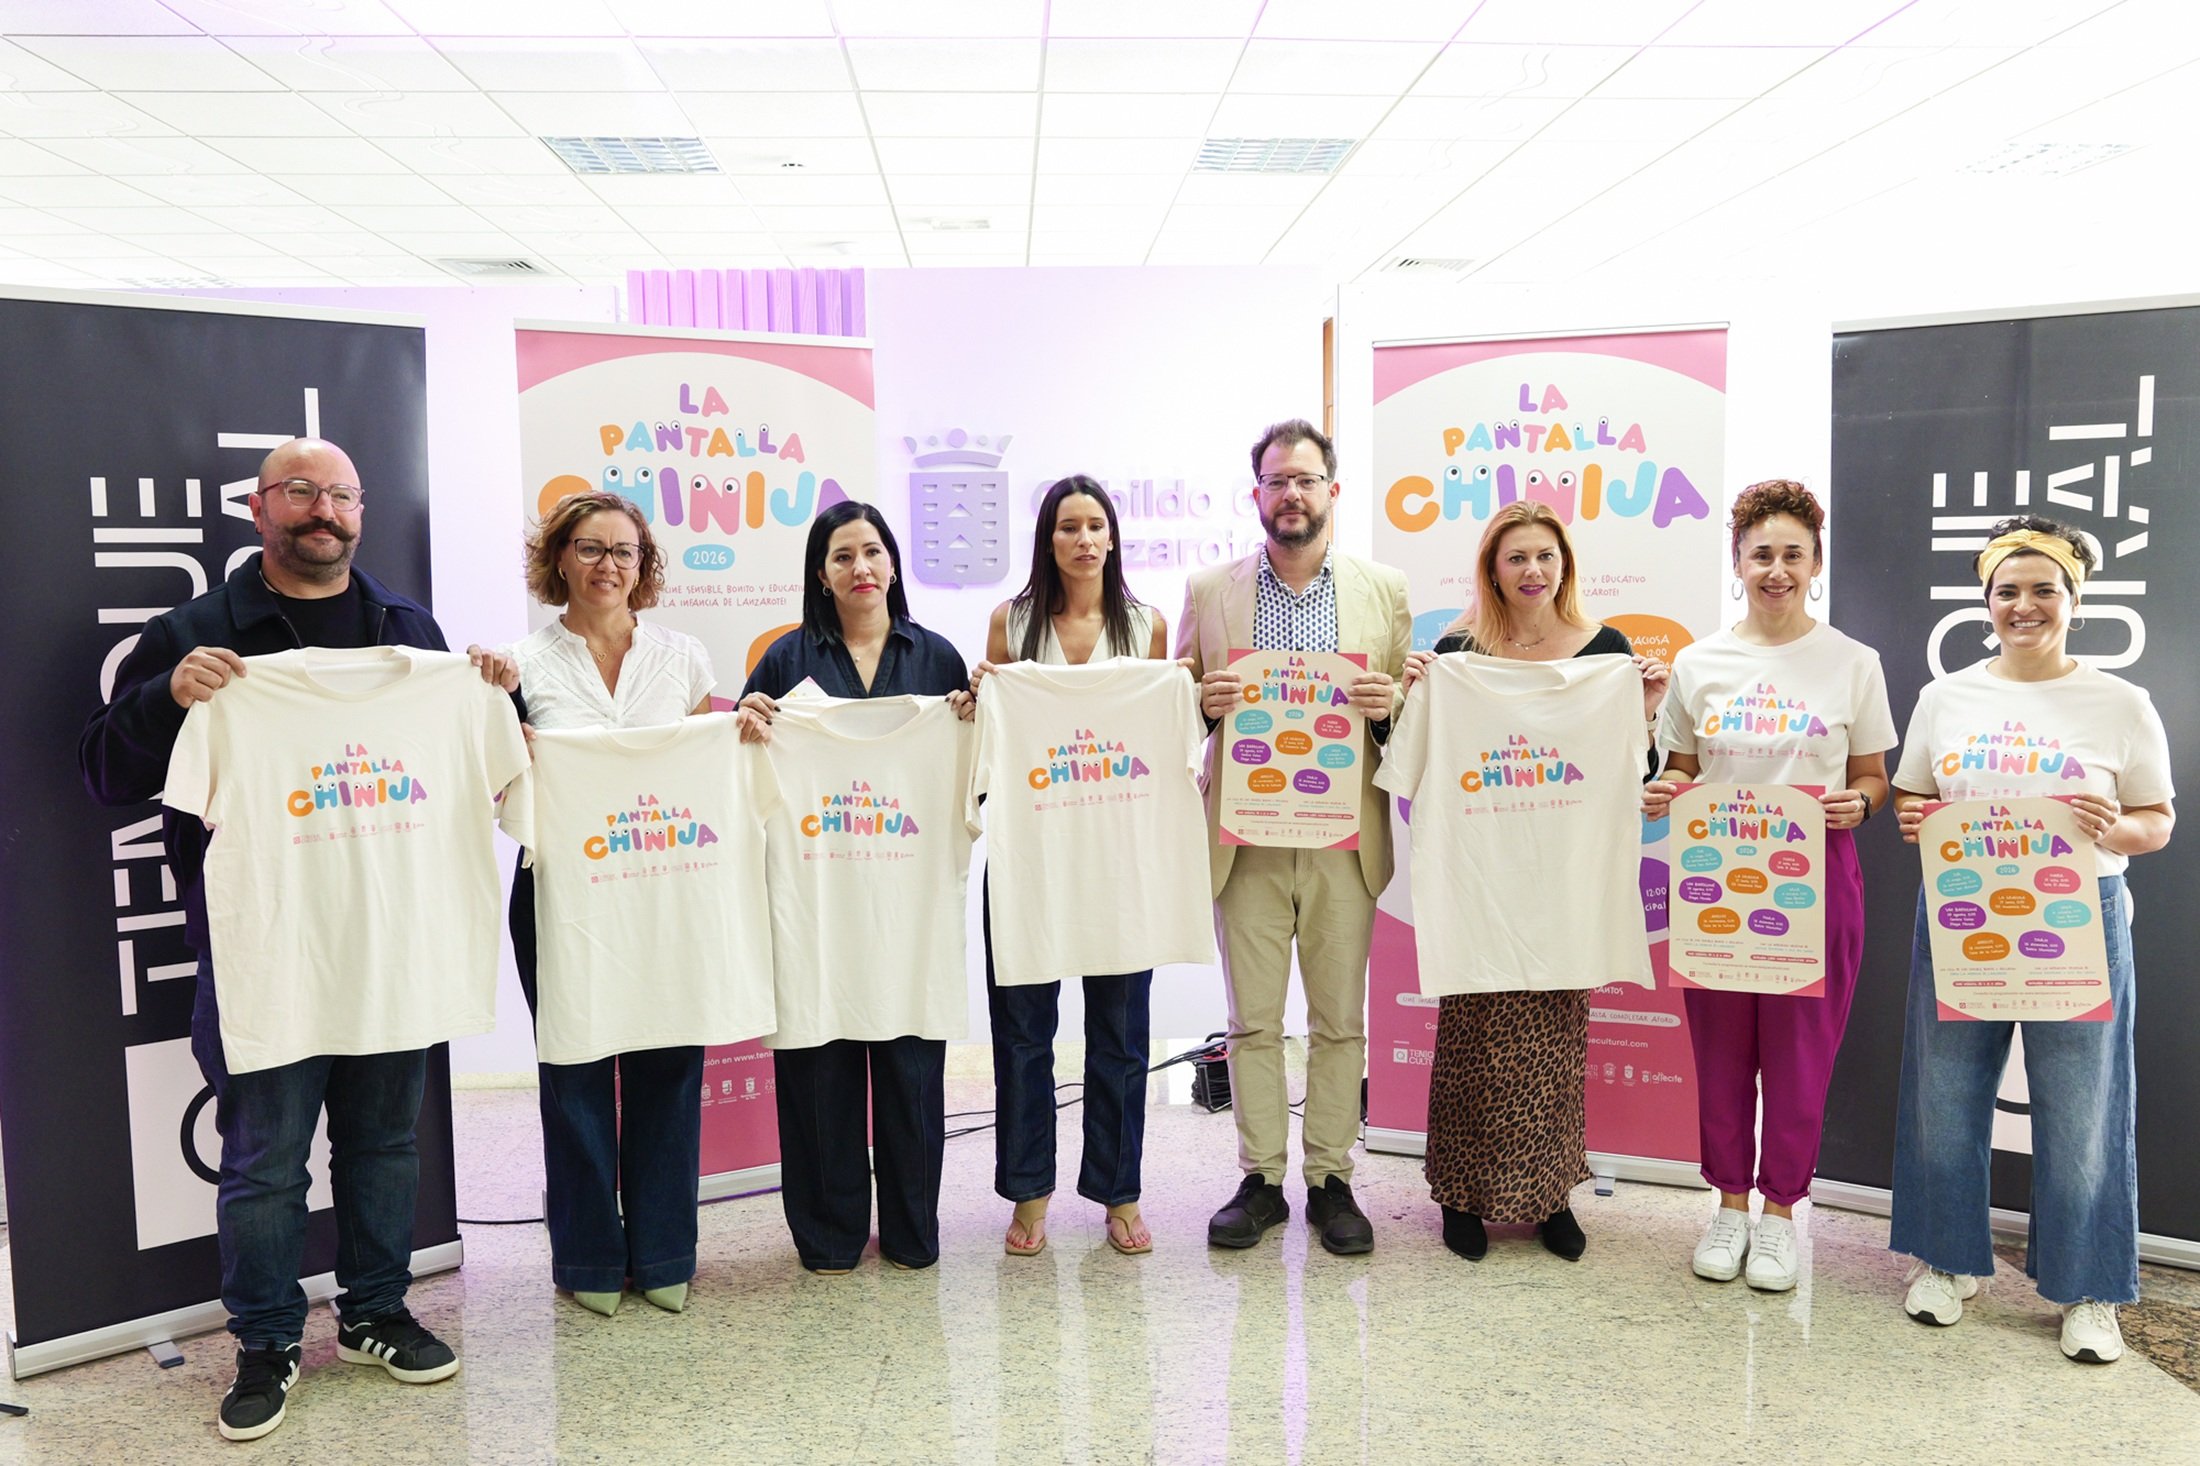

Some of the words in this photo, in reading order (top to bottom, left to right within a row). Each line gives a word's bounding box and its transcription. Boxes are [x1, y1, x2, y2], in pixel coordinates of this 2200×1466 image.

[679, 383, 730, 417] LA
[1519, 383, 1568, 414] LA
[599, 420, 806, 463] PANTALLA
[1443, 416, 1647, 457] PANTALLA
[1031, 478, 1205, 518] bildo
[1385, 460, 1710, 533] CHINIJA
[692, 550, 727, 566] 2026
[1458, 577, 1472, 585] CICL
[1601, 575, 1646, 583] EDUCATIVO
[727, 585, 755, 594] BONITO
[769, 584, 805, 593] EDUCATIV
[663, 599, 676, 608] LA
[680, 599, 719, 608] INFANCIA
[723, 597, 732, 607] DE
[1627, 634, 1670, 646] RACIOSA
[1289, 656, 1305, 667] LA
[1263, 668, 1330, 683] PANTALLA
[1242, 682, 1349, 707] CHINIJA
[1757, 683, 1776, 695] LA
[1704, 711, 1828, 737] CHINIJA
[2004, 721, 2026, 732] LA
[1075, 729, 1095, 740] LA
[1509, 734, 1528, 746] LA
[1967, 734, 2060, 750] PANTALLA
[346, 743, 368, 757] LA
[1048, 741, 1125, 759] PANTALLA
[1481, 746, 1559, 763] PANTALLA
[311, 758, 404, 780] PANTALLA
[1028, 755, 1150, 790] CHINIJA
[1942, 749, 2086, 780] CHINIJA
[1460, 761, 1584, 792] CHINIJA
[853, 780, 871, 792] LA
[287, 776, 427, 817] CHINIJA
[638, 794, 659, 807] LA
[822, 794, 899, 810] PANTALLA
[1737, 789, 1756, 801] LA
[606, 807, 692, 827] PANTALLA
[1709, 802, 1784, 816] PANTALLA
[1990, 805, 2011, 817] LA
[800, 811, 919, 837] CHINIJA
[1687, 816, 1806, 843] CHINIJA
[1960, 819, 2045, 834] PANTALLA
[584, 822, 718, 860] CHINIJA
[1940, 833, 2073, 862] CHINIJA
[1646, 887, 1667, 897] 12:00
[1645, 902, 1666, 912] cipal
[1588, 1038, 1648, 1048] ecultural.com
[1409, 1049, 1434, 1059] TENIQ
